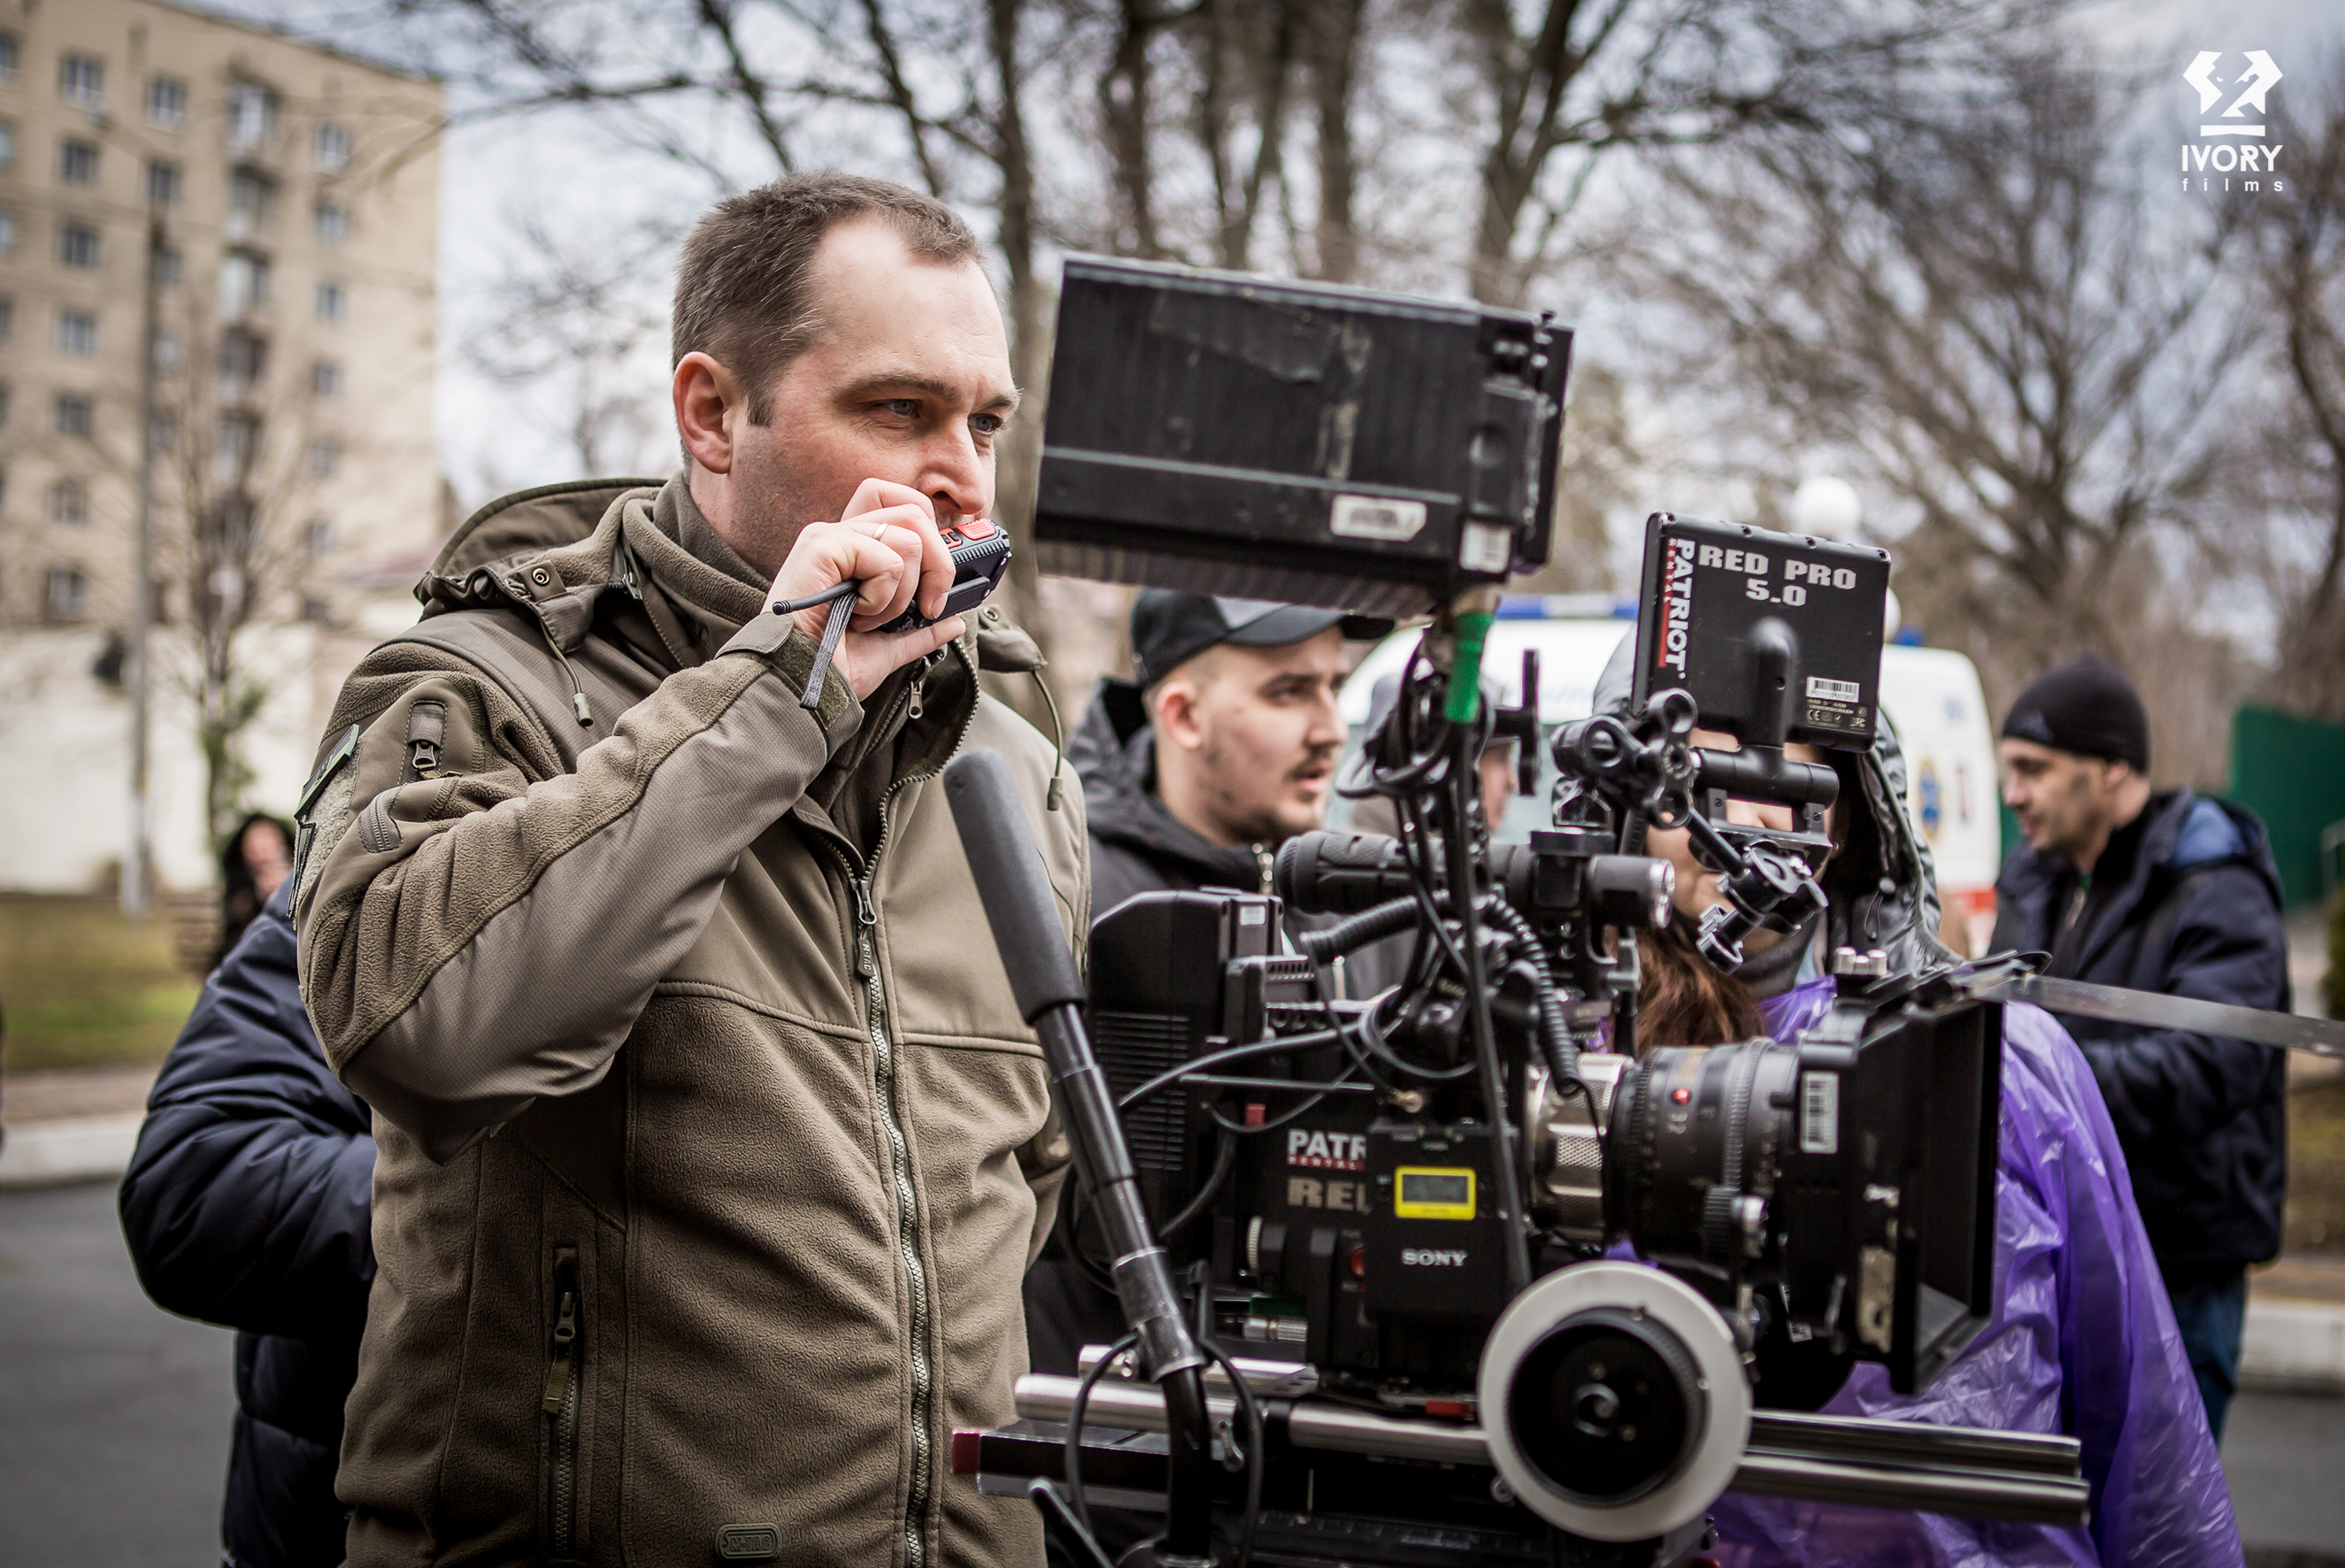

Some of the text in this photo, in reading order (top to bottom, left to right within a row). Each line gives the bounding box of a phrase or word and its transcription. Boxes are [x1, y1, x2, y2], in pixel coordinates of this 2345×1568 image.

[1664, 538, 1677, 603] RENTAL
[1697, 543, 1857, 590] RED PRO
[1665, 538, 1695, 673] PATRIOT
[1746, 578, 1807, 607] 5.0
[1401, 1249, 1468, 1266] SONY
